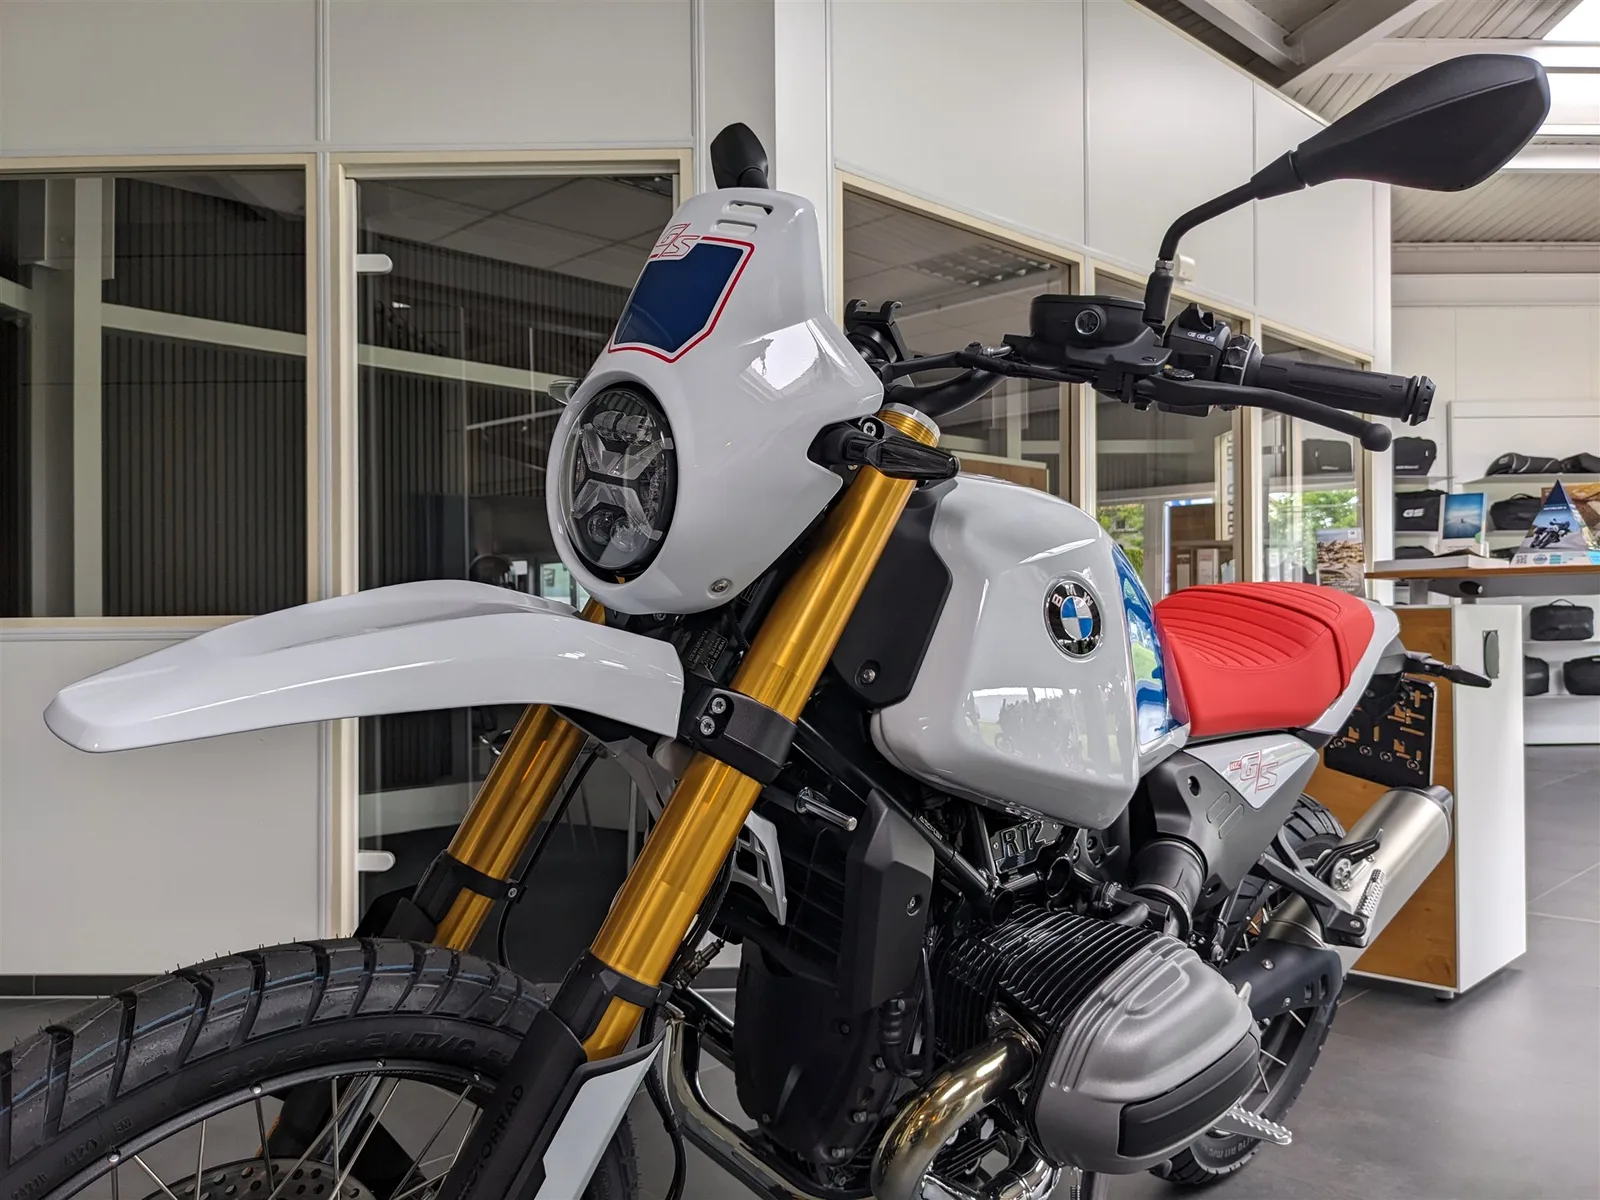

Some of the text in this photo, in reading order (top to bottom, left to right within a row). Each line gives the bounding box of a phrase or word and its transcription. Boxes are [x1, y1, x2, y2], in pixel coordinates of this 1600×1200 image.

[1402, 507, 1425, 518] GS
[1051, 584, 1094, 608] BMW
[1000, 821, 1046, 858] R12
